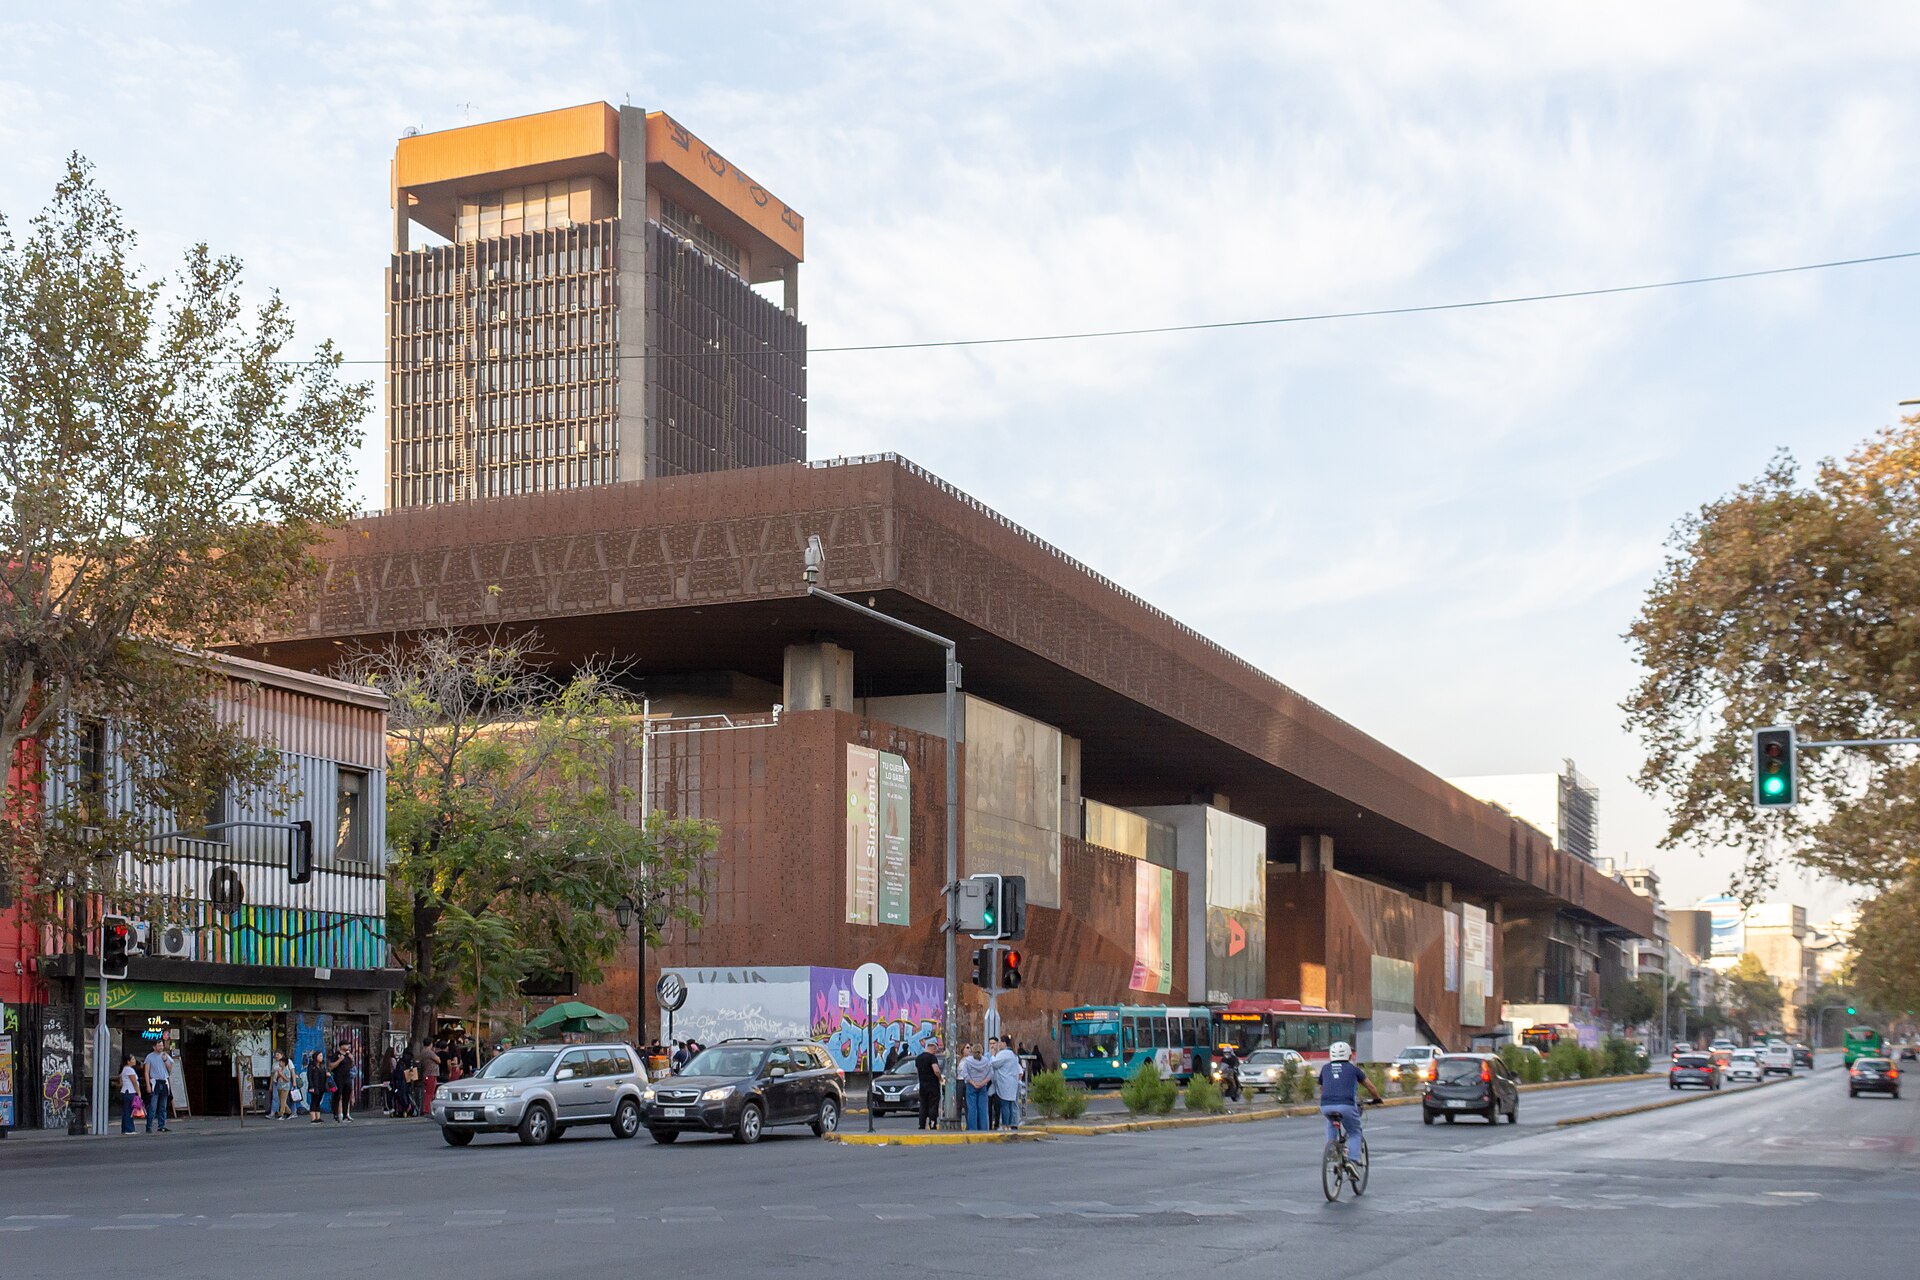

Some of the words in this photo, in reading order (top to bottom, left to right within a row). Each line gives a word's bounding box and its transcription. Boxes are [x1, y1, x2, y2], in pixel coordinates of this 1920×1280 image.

[85, 984, 132, 1006] CRSTAL
[163, 991, 222, 1004] RESTAURANT
[224, 993, 276, 1005] CANTABRICO
